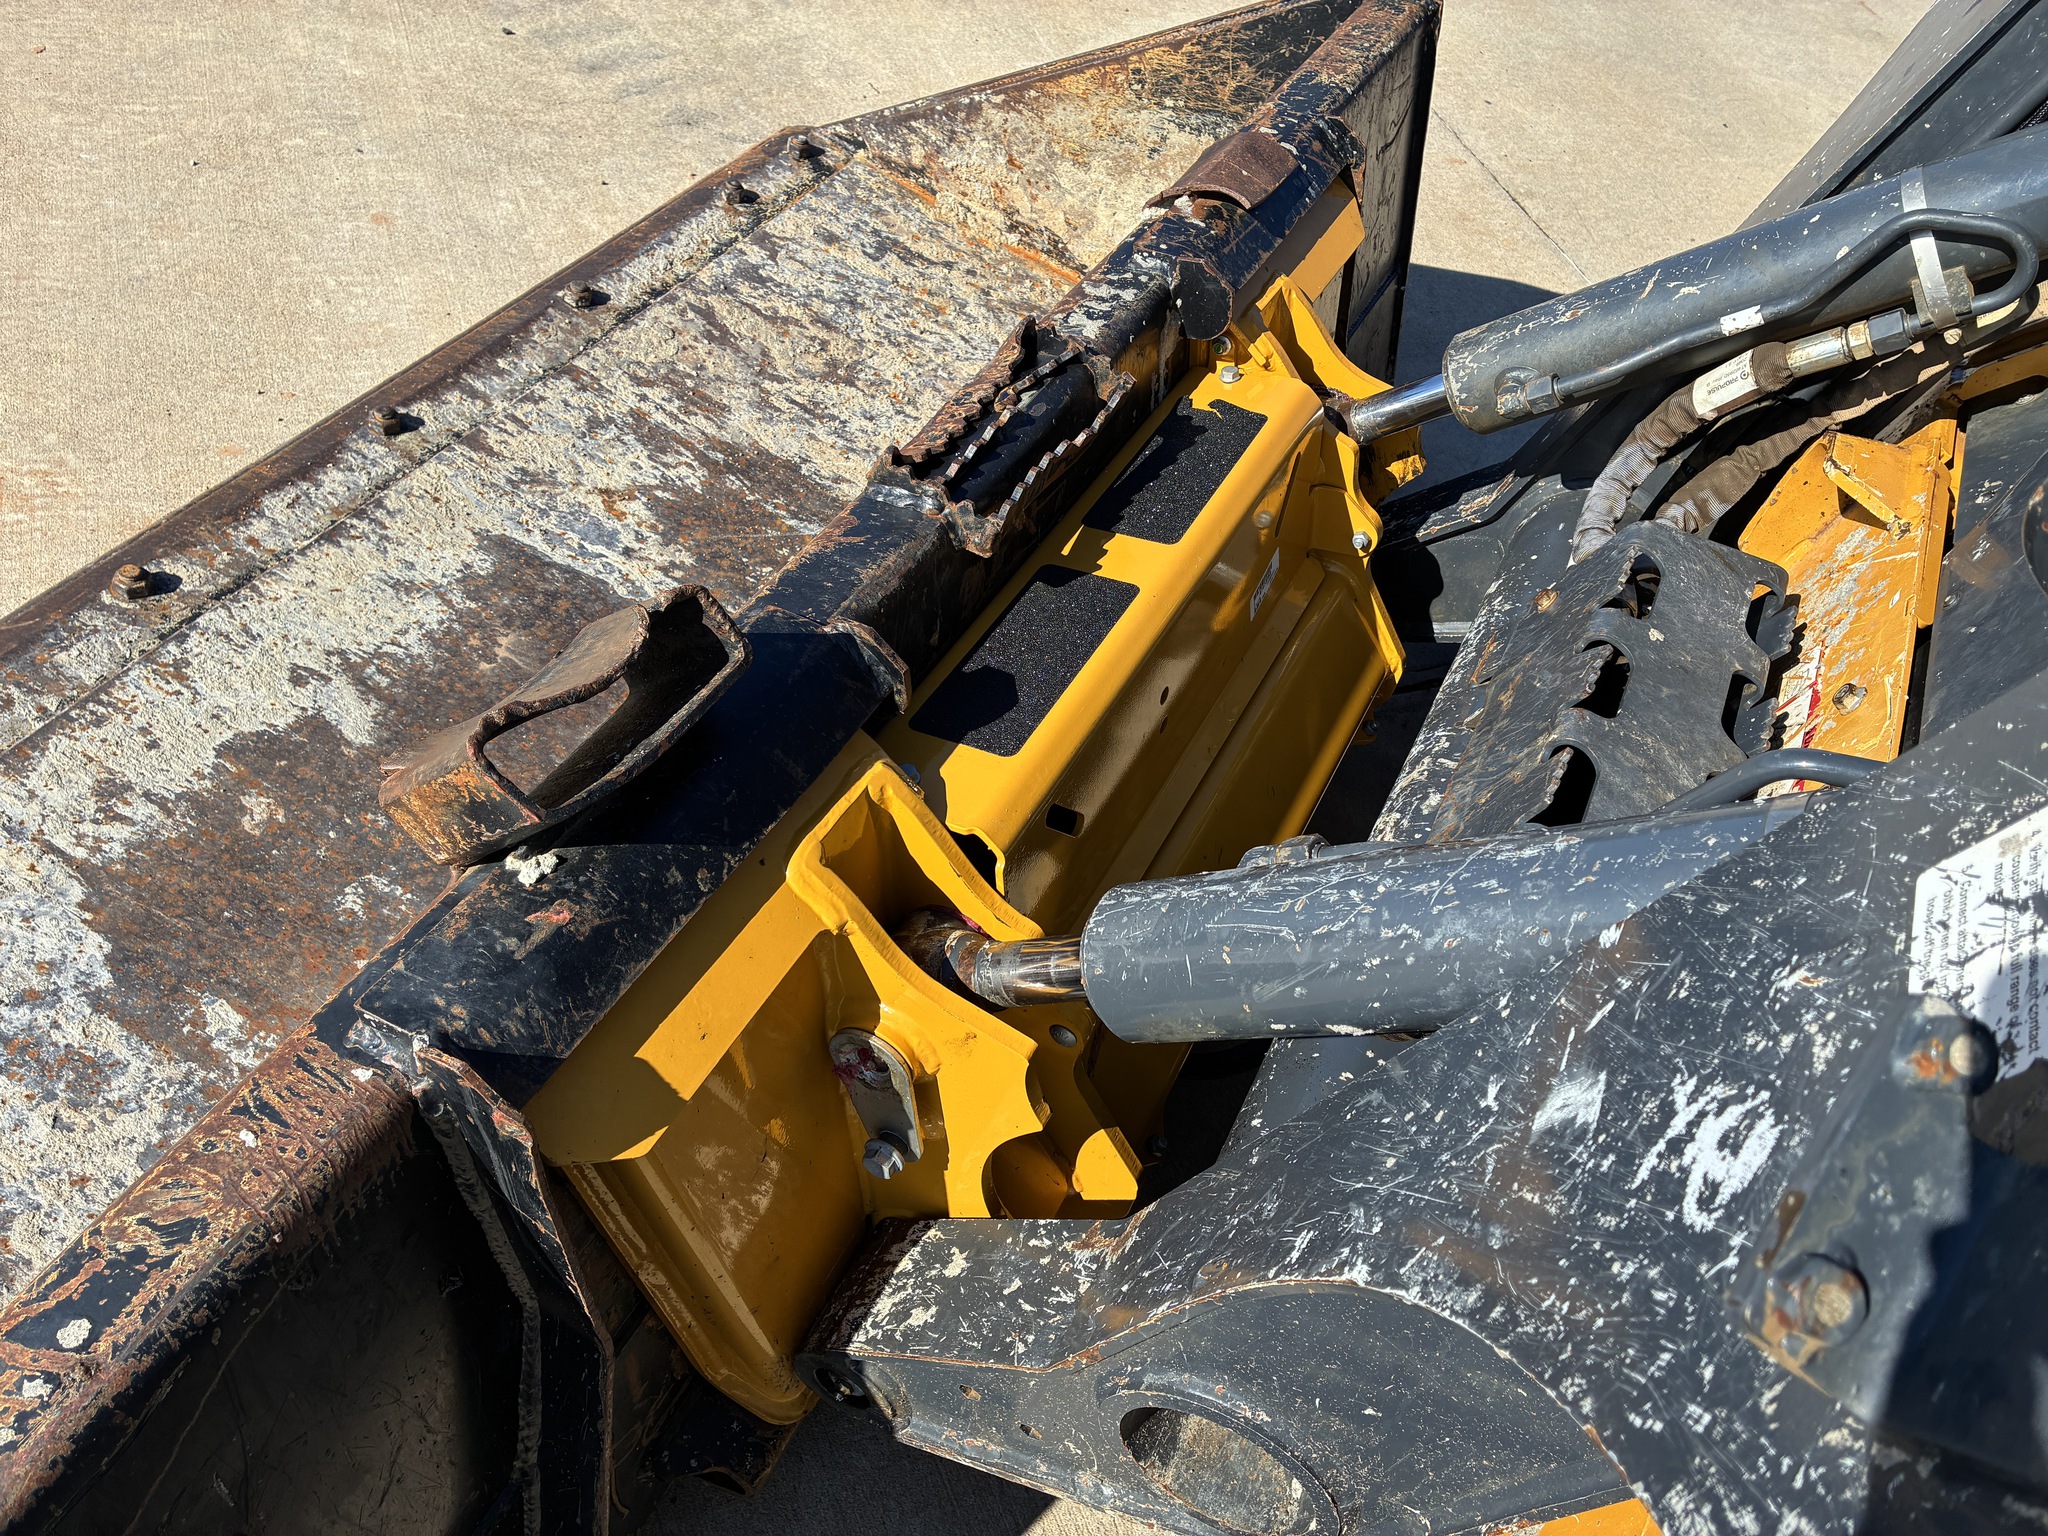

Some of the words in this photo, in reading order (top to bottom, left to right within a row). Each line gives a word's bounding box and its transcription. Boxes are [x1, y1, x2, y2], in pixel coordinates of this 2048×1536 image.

[1706, 376, 1739, 395] PROPULSE
[1958, 880, 1972, 927] Connect
[1939, 953, 1949, 973] not
[2010, 953, 2024, 974] full
[2006, 975, 2020, 1012] range
[2029, 978, 2041, 1003] not
[2027, 1003, 2041, 1055] contact
